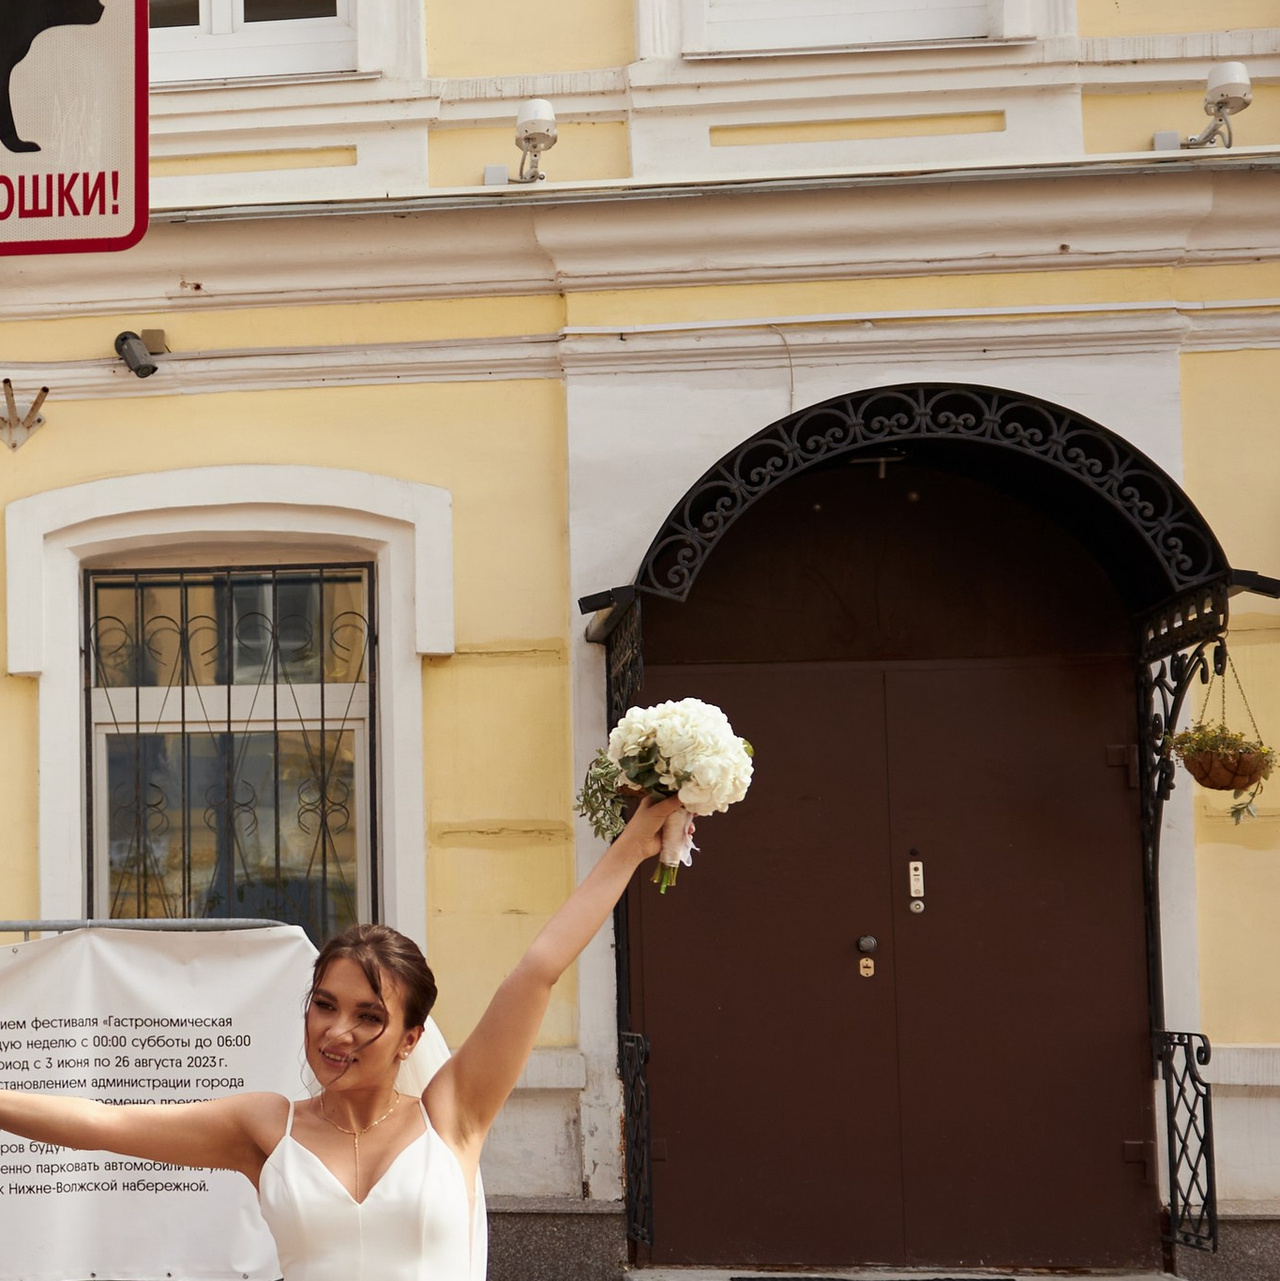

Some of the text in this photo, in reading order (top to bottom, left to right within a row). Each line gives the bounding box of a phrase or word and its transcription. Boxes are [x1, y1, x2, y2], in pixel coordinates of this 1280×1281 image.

[31, 1016, 99, 1031] фестиваля
[102, 1015, 233, 1029] «Гастрономическая
[27, 1038, 77, 1050] неделю
[81, 1038, 89, 1048] с
[93, 1035, 127, 1048] 00:00
[131, 1035, 191, 1050] субботы
[195, 1037, 212, 1050] до
[217, 1034, 251, 1047] 06:00
[33, 1059, 41, 1069] с
[45, 1057, 53, 1069] 3
[57, 1058, 90, 1069] июня
[94, 1057, 111, 1068] по
[114, 1055, 130, 1068] 26
[134, 1057, 182, 1070] августа
[91, 1077, 191, 1091] администрации
[195, 1077, 245, 1090] города
[36, 1161, 100, 1176] парковать
[9, 1179, 118, 1195] Нижне-Волжской
[122, 1179, 209, 1194] набережной.
